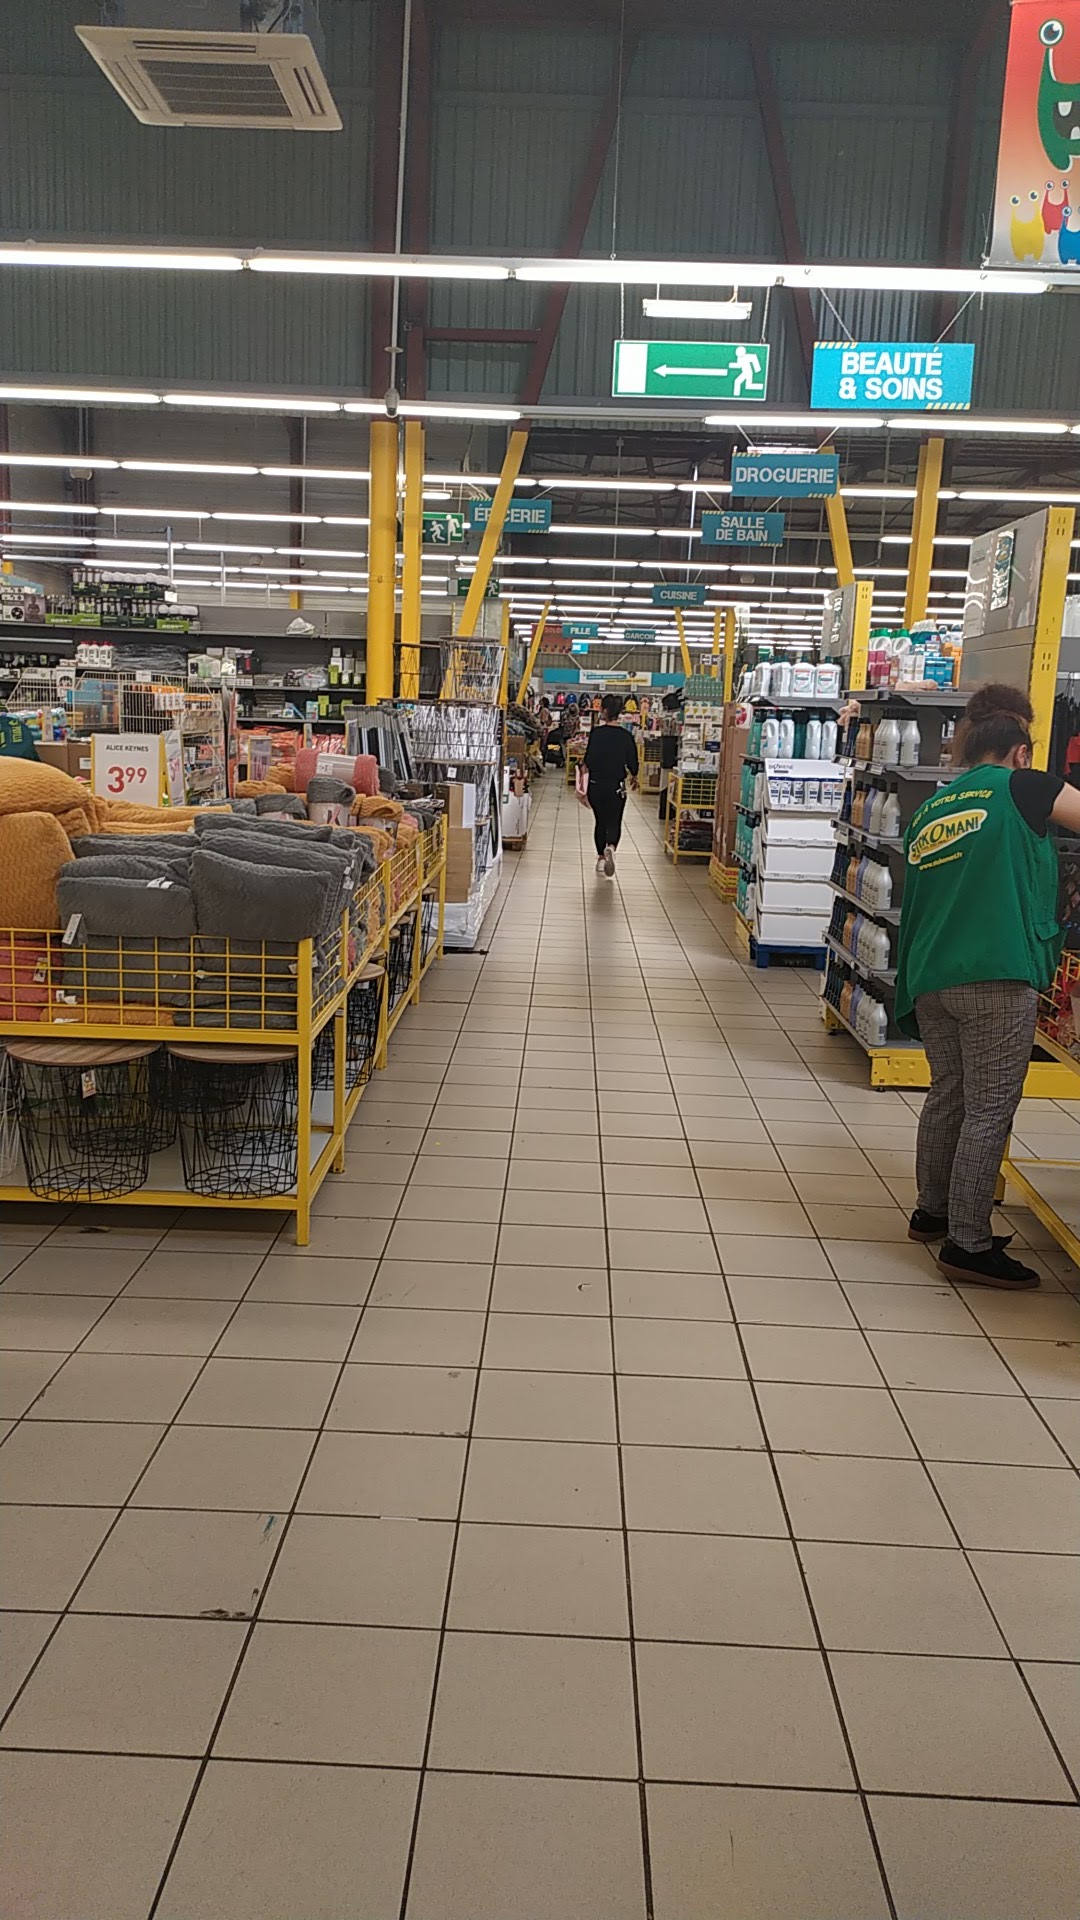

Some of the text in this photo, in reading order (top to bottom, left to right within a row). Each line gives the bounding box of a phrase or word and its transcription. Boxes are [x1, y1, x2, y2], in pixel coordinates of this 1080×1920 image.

[841, 347, 943, 376] BEAUTÉ
[838, 377, 943, 401] & SOINS
[734, 466, 835, 485] DROGUERIE
[720, 516, 765, 530] SALLE
[715, 528, 769, 542] DE BAIN
[659, 589, 698, 601] CUISINE
[570, 627, 591, 635] FILLE
[105, 744, 124, 752] ALICE
[931, 794, 957, 808] VOTRE
[957, 790, 993, 800] SERVICE
